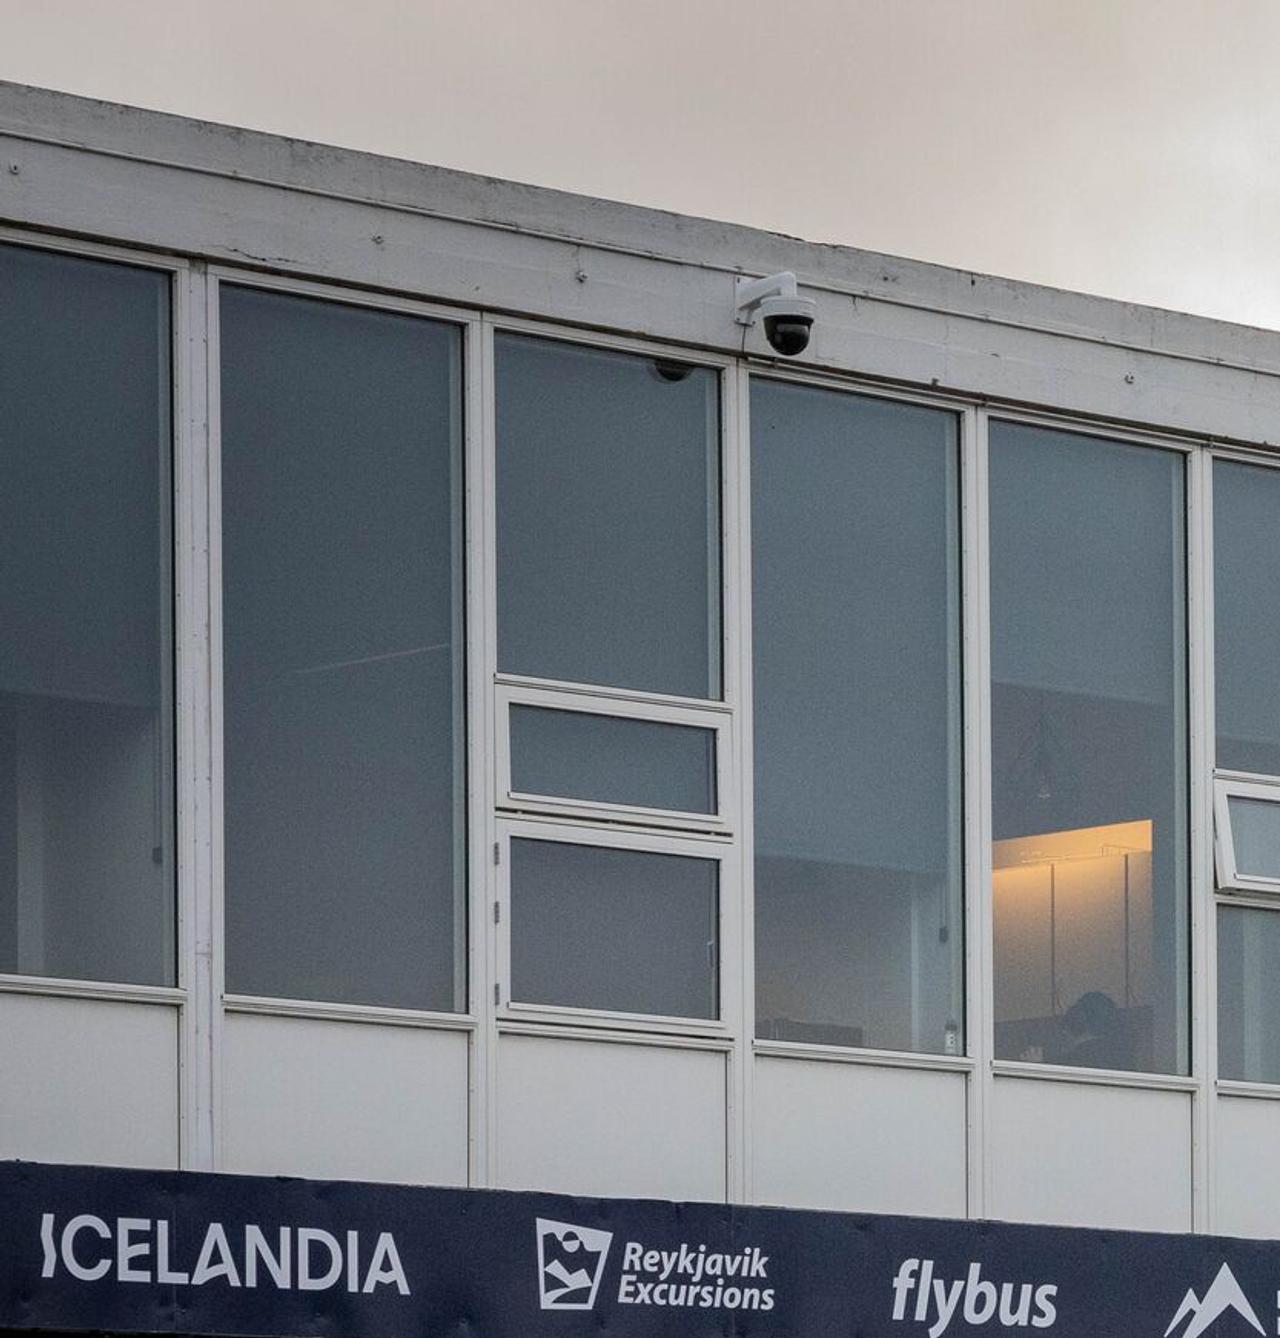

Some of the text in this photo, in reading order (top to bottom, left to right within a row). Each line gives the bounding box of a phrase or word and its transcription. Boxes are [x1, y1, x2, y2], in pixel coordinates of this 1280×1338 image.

[40, 1213, 411, 1295] ICELANDIA
[622, 1242, 769, 1281] Reykjavik
[617, 1274, 775, 1311] Excursions
